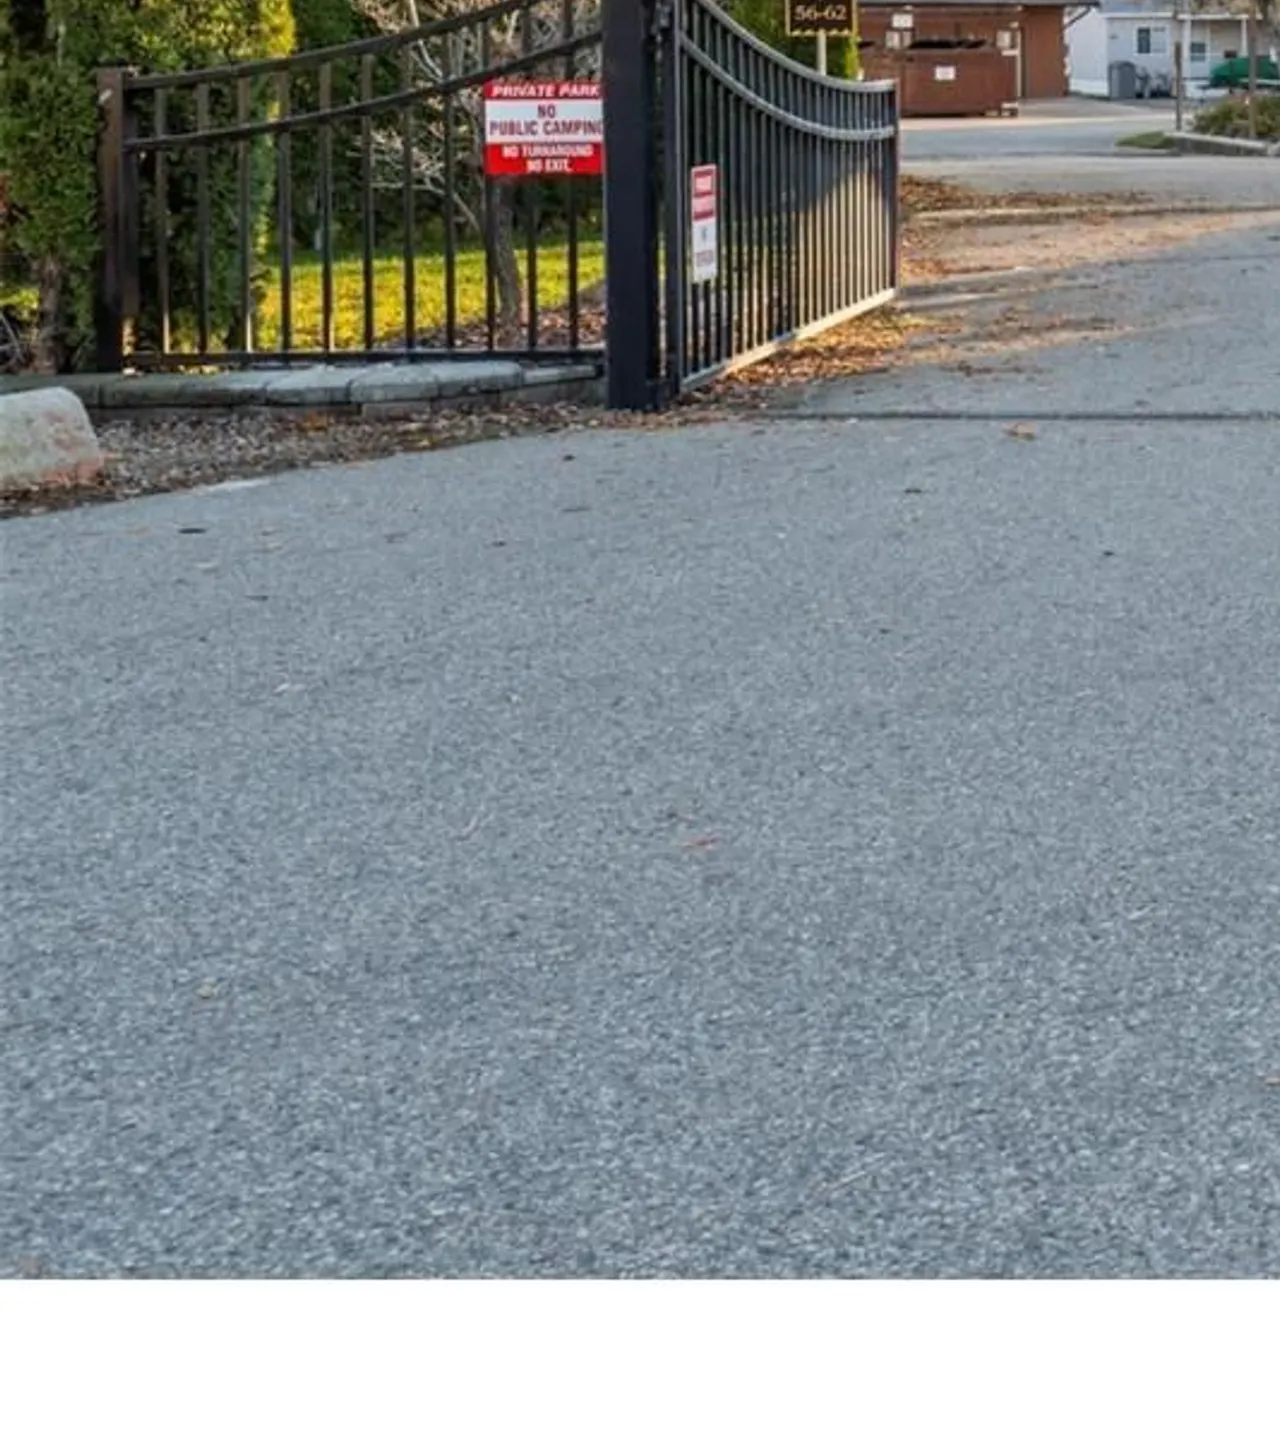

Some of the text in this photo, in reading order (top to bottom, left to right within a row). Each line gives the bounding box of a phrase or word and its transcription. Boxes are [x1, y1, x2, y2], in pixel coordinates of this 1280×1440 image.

[491, 84, 600, 97] PRIVATE PARK
[537, 104, 556, 118] NO
[490, 121, 539, 135] PUBLIC
[502, 145, 519, 157] NO
